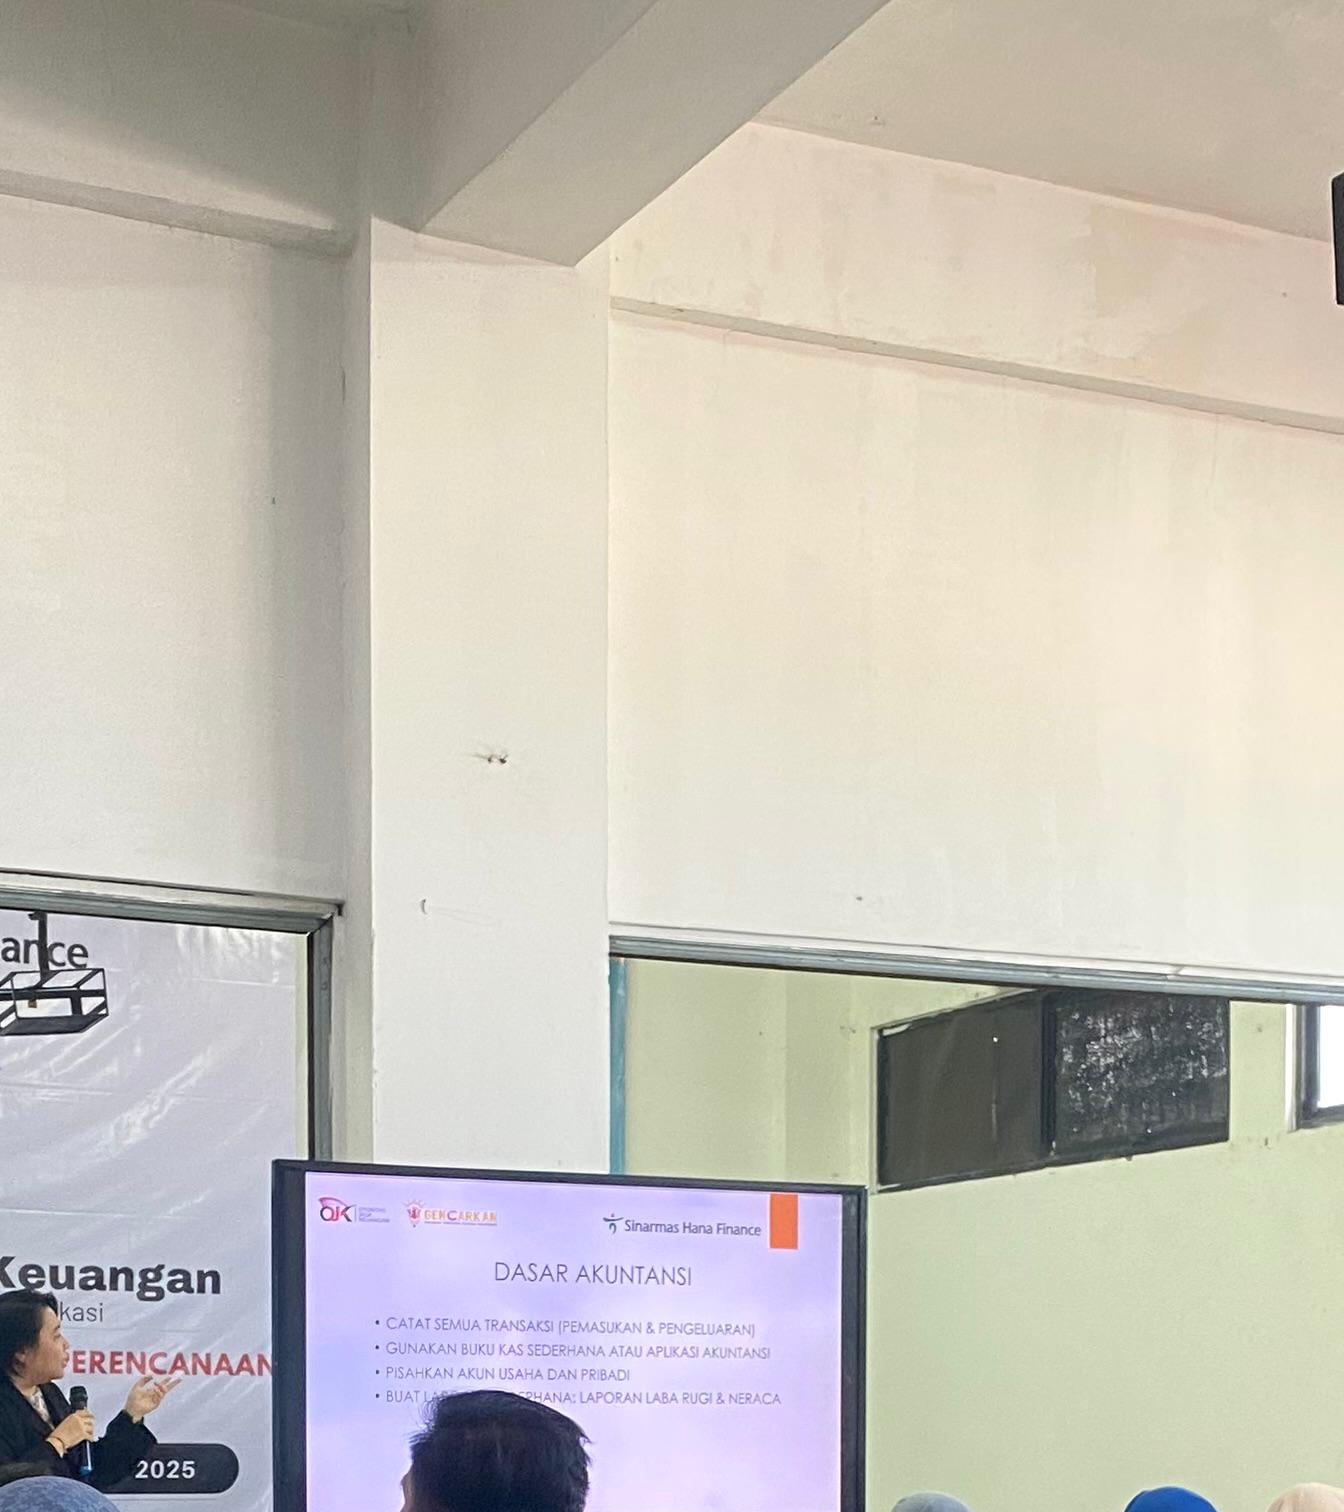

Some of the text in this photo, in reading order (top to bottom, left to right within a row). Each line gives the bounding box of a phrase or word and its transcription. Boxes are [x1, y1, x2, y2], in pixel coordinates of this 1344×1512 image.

[319, 1203, 355, 1222] OJK
[624, 1219, 761, 1236] Sinarmas Hana Finance
[495, 1261, 692, 1286] DASAR AKUNTANSI
[60, 1301, 103, 1322] kasi
[386, 1317, 756, 1338] CATAT SEMUA TRANSAKSI (PEMASUKAN & PENGELUARAN)
[386, 1341, 771, 1359] GUNAKAN BUKU KAS SEDERHANA ATAU APLIKASI AKUNTANSI
[72, 1350, 272, 1377] ERENCANAAN
[386, 1366, 630, 1381] PISAHKAN AKUN USAHA DAN PRIBADI
[386, 1390, 421, 1403] BUAT
[580, 1391, 642, 1405] LAPORAN
[646, 1391, 678, 1405] LABA
[682, 1392, 712, 1405] RUGI
[716, 1393, 725, 1405] &
[729, 1393, 782, 1405] NERACA
[135, 1460, 196, 1479] 2025
